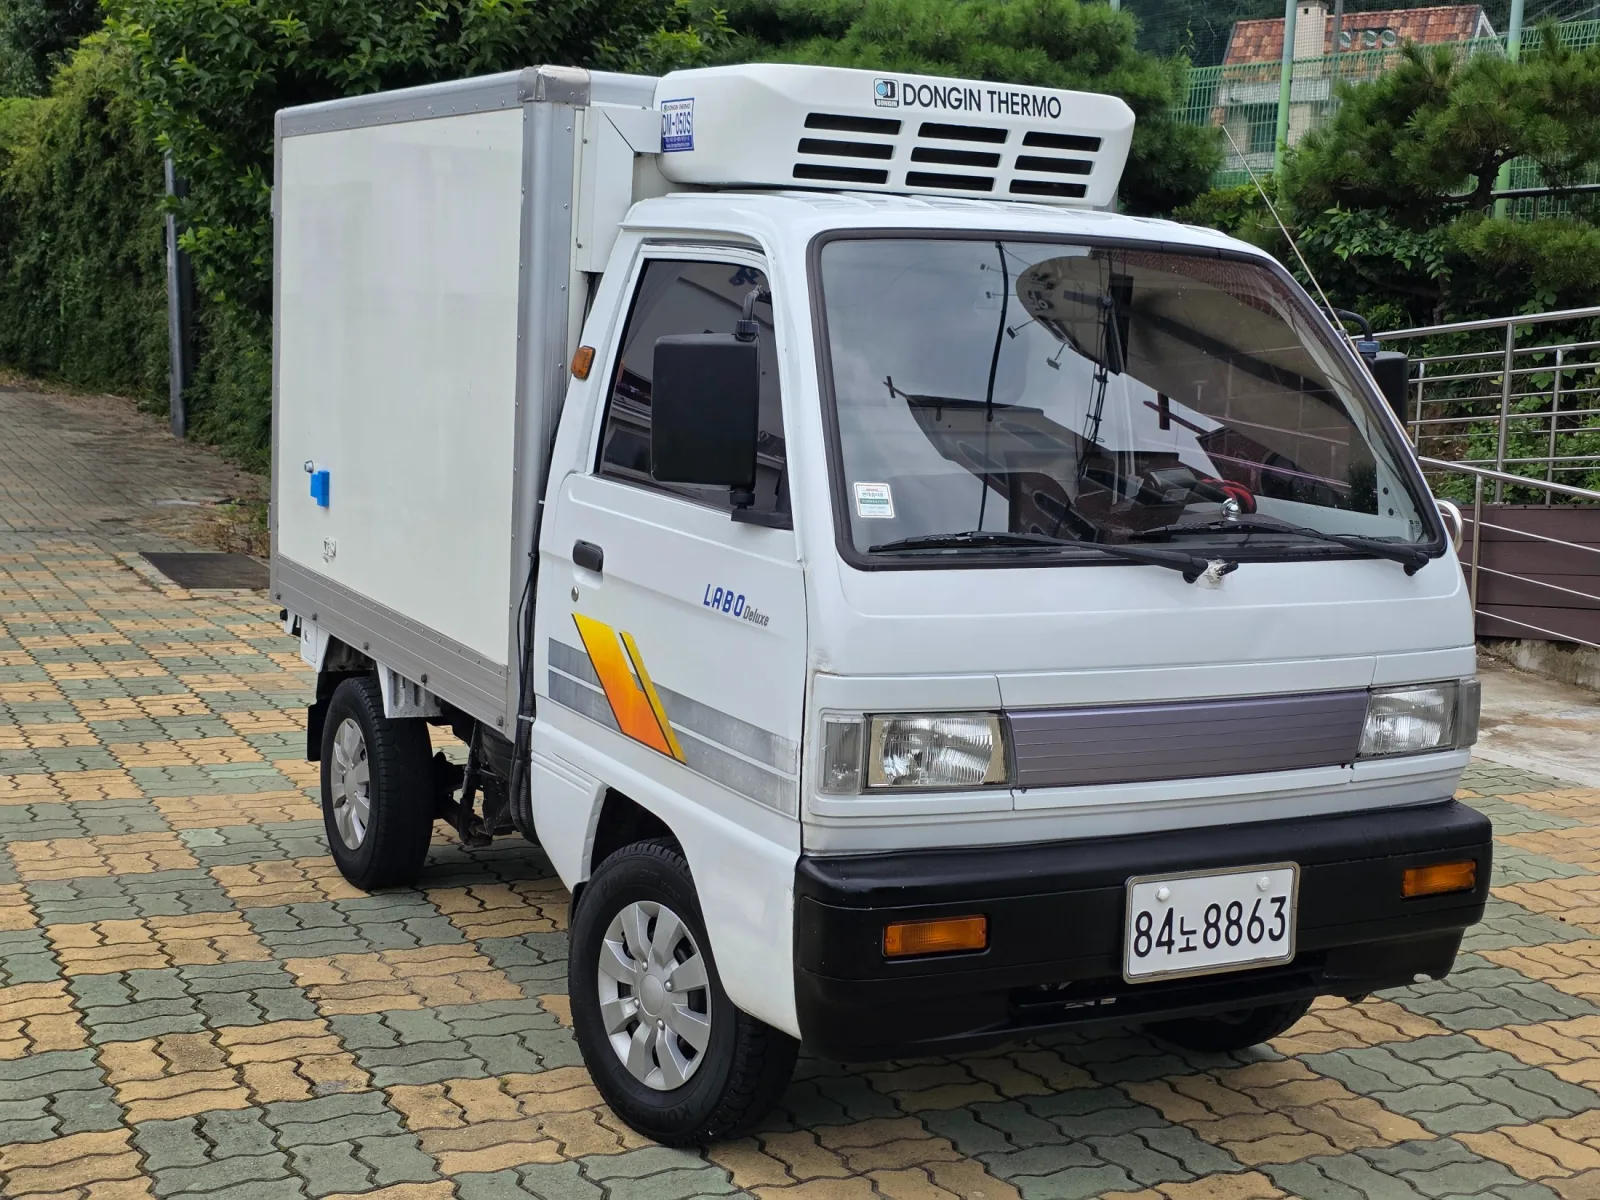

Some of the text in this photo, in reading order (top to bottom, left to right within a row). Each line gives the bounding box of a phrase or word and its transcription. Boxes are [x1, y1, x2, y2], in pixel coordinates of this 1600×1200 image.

[876, 99, 898, 108] DONGIN
[903, 83, 1062, 119] DONGIN THERMO
[662, 111, 691, 136] DM-050S
[703, 583, 770, 627] LABO Deluxe
[1133, 895, 1287, 958] 84노8863
